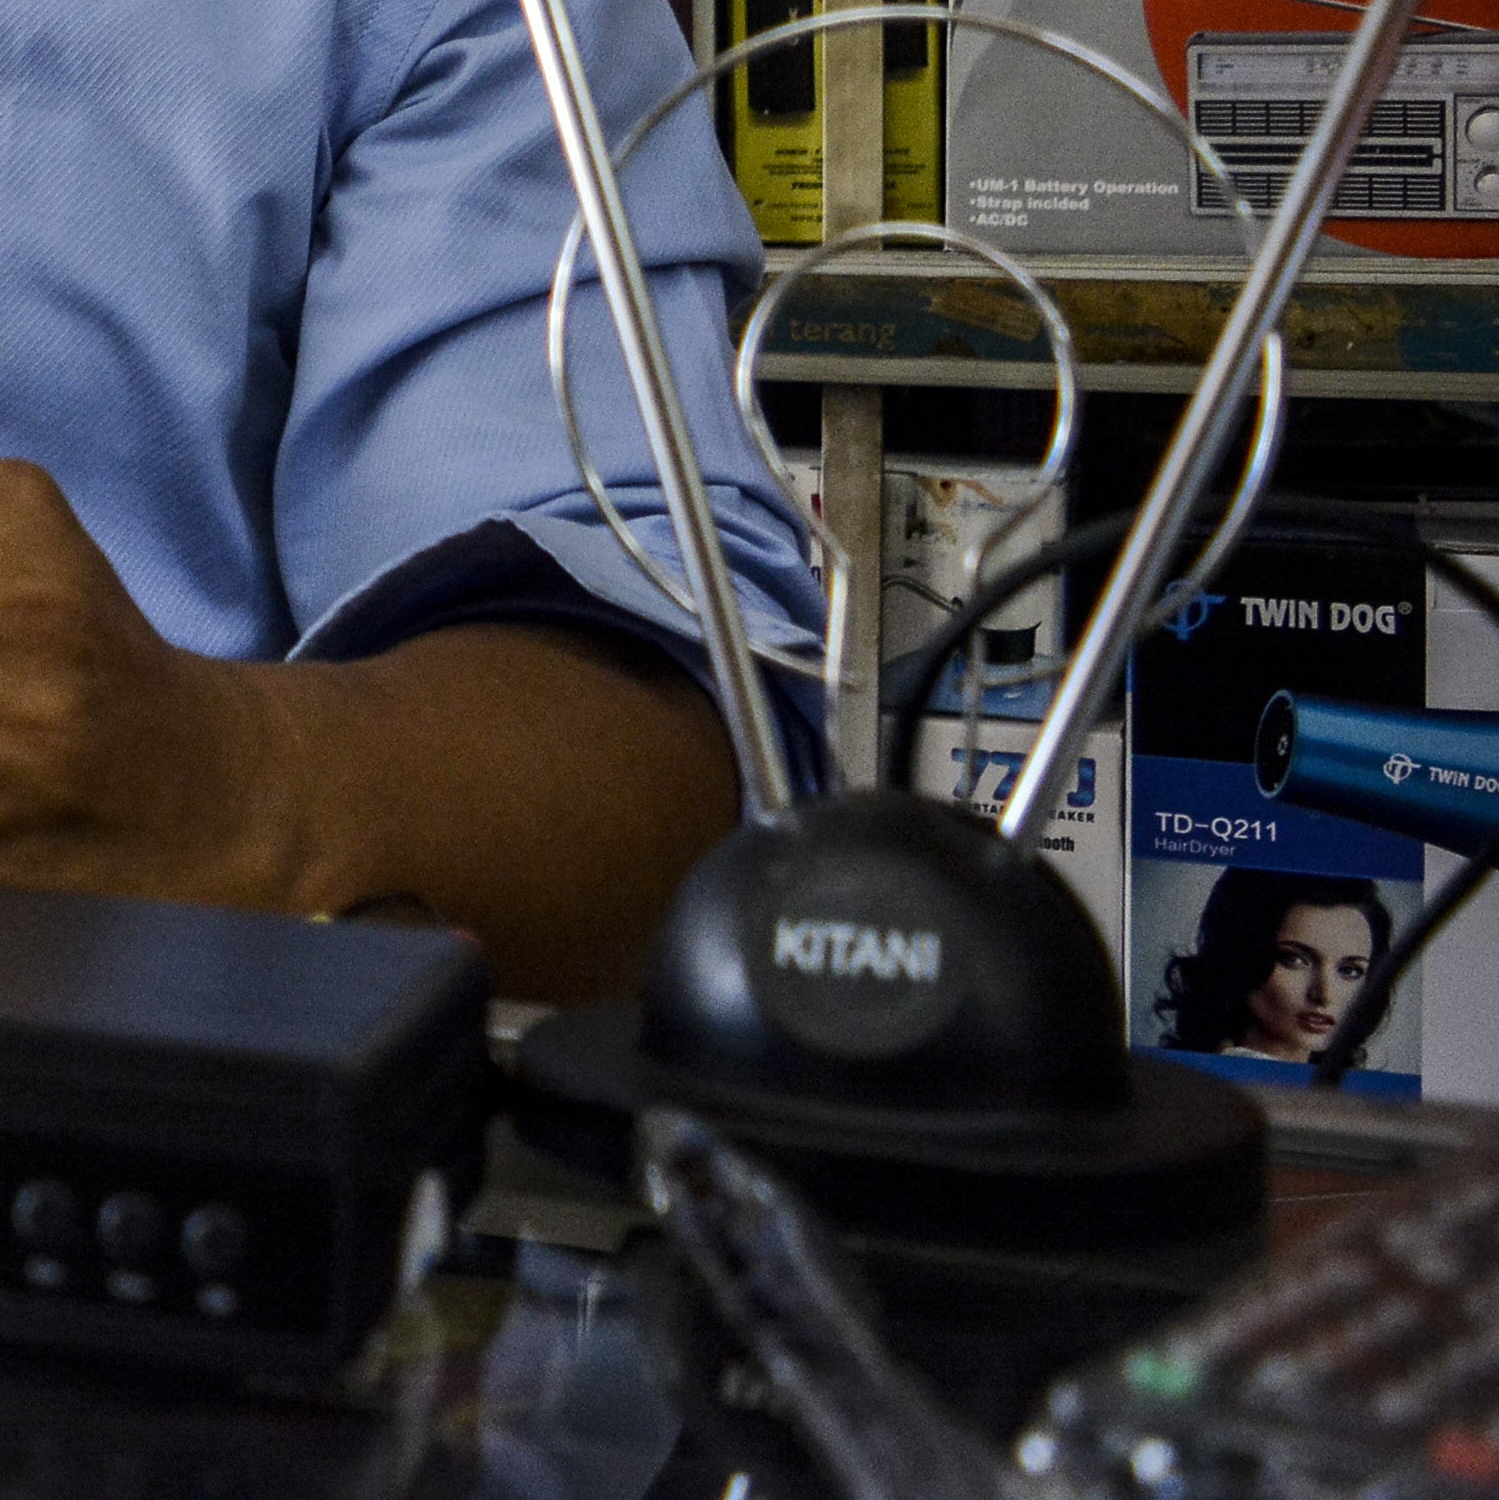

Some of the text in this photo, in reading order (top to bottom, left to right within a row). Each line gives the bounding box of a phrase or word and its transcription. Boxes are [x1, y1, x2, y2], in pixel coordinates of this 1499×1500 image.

[1023, 179, 1089, 197] Battery
[1093, 179, 1180, 196] Operation
[789, 317, 899, 350] terang
[1240, 596, 1398, 635] TWIN DOG
[1428, 767, 1472, 788] TWIN
[1154, 811, 1278, 843] TD-Q211
[1154, 836, 1237, 859] HairDryer
[773, 917, 941, 984] KITANI
